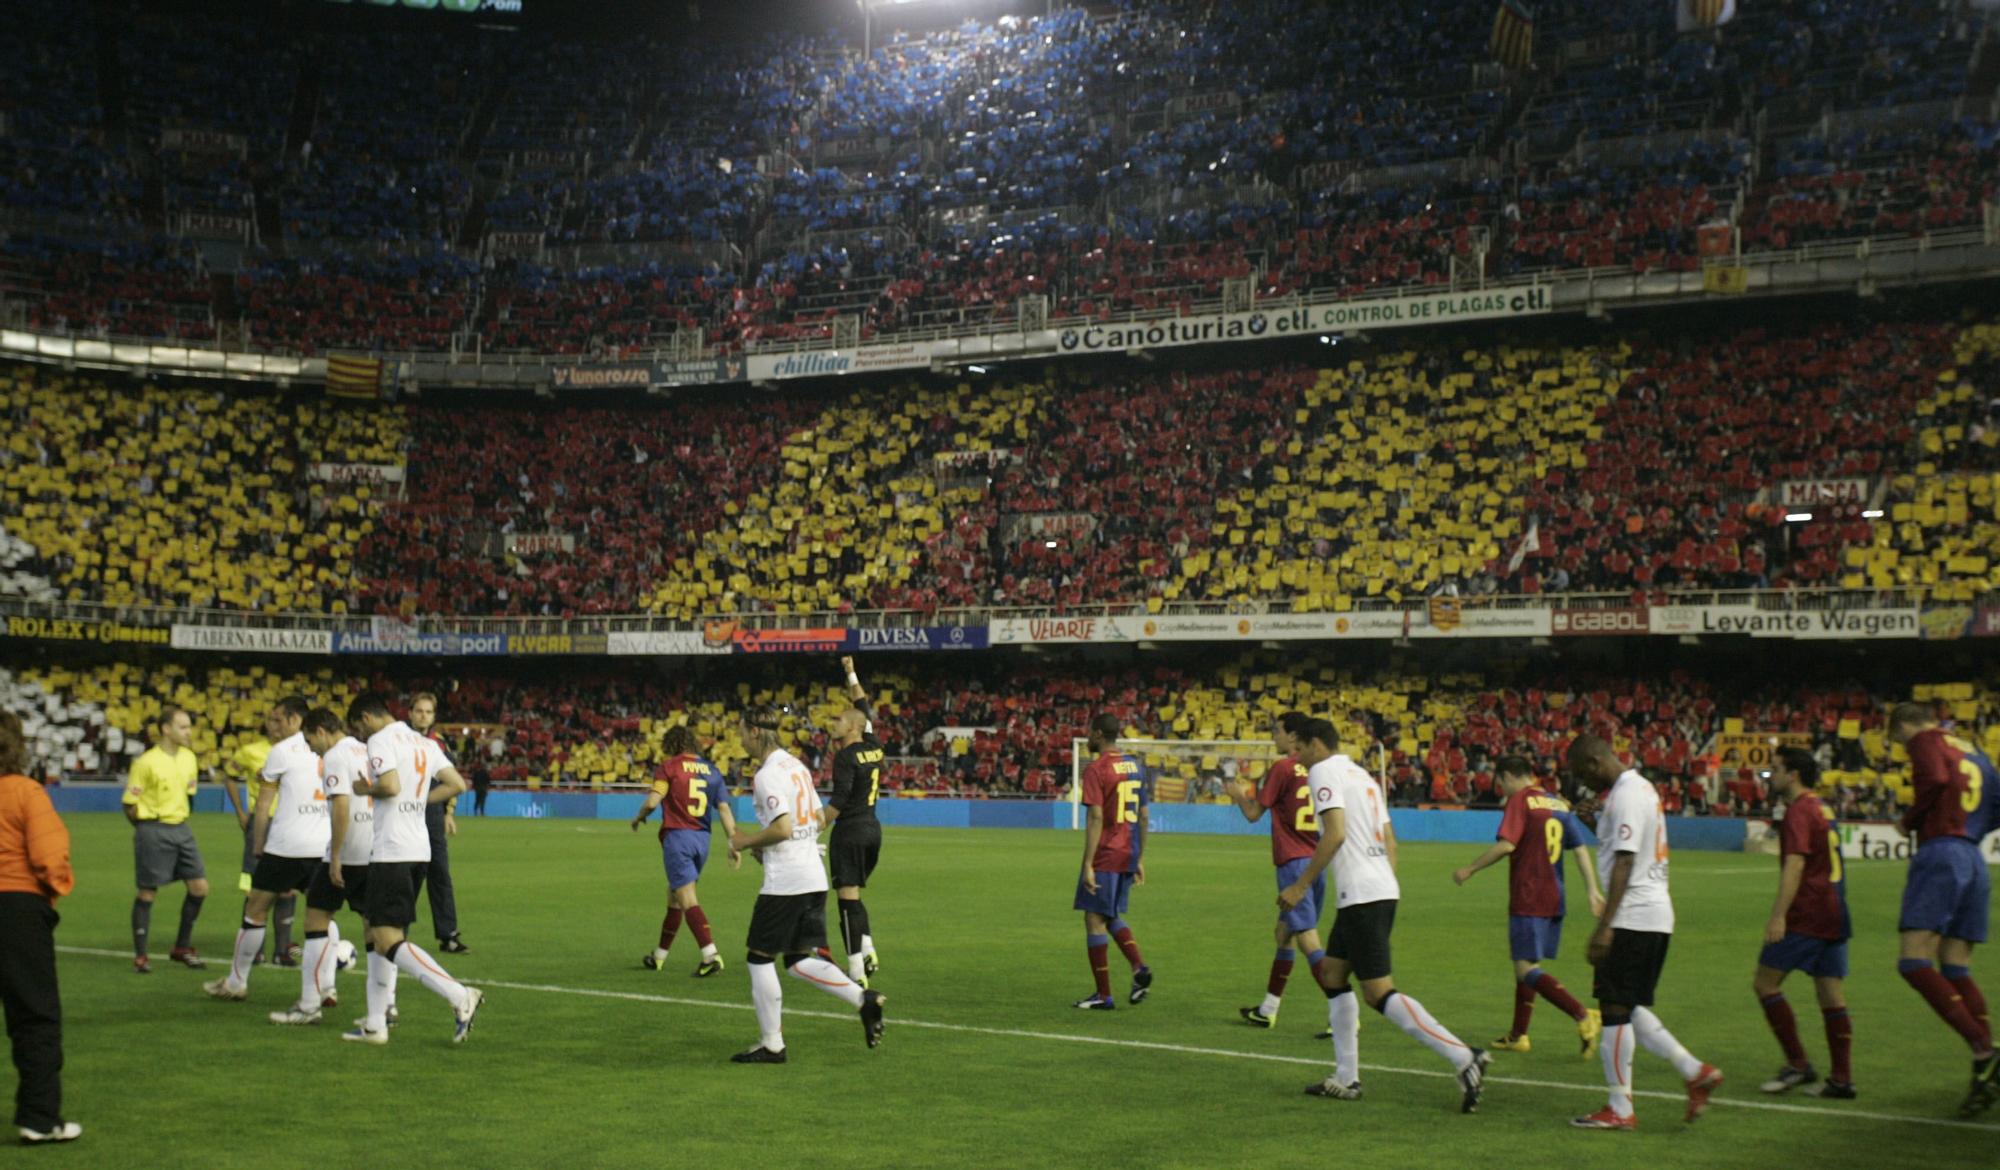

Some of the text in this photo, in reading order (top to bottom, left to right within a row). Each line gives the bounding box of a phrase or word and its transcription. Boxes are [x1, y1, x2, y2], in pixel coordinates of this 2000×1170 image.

[1324, 306, 1402, 325] CONTROL
[1409, 302, 1431, 318] DE
[1438, 295, 1505, 316] PLAGAS
[1083, 317, 1244, 349] Canoturia
[332, 465, 382, 482] MARCA
[8, 616, 83, 640] ROLEX
[1030, 618, 1096, 640] VELARTE
[1703, 610, 1810, 632] Levante
[1821, 609, 1915, 635] Wagen
[193, 631, 327, 650] TABERNA ALKAZAR
[508, 635, 572, 653] FLYCAR
[859, 628, 929, 645] DIVESA
[682, 761, 711, 776] PUYOL
[1959, 758, 1983, 812] 3
[687, 778, 707, 818] 5
[1116, 780, 1142, 824] 15
[1544, 818, 1563, 864] 8
